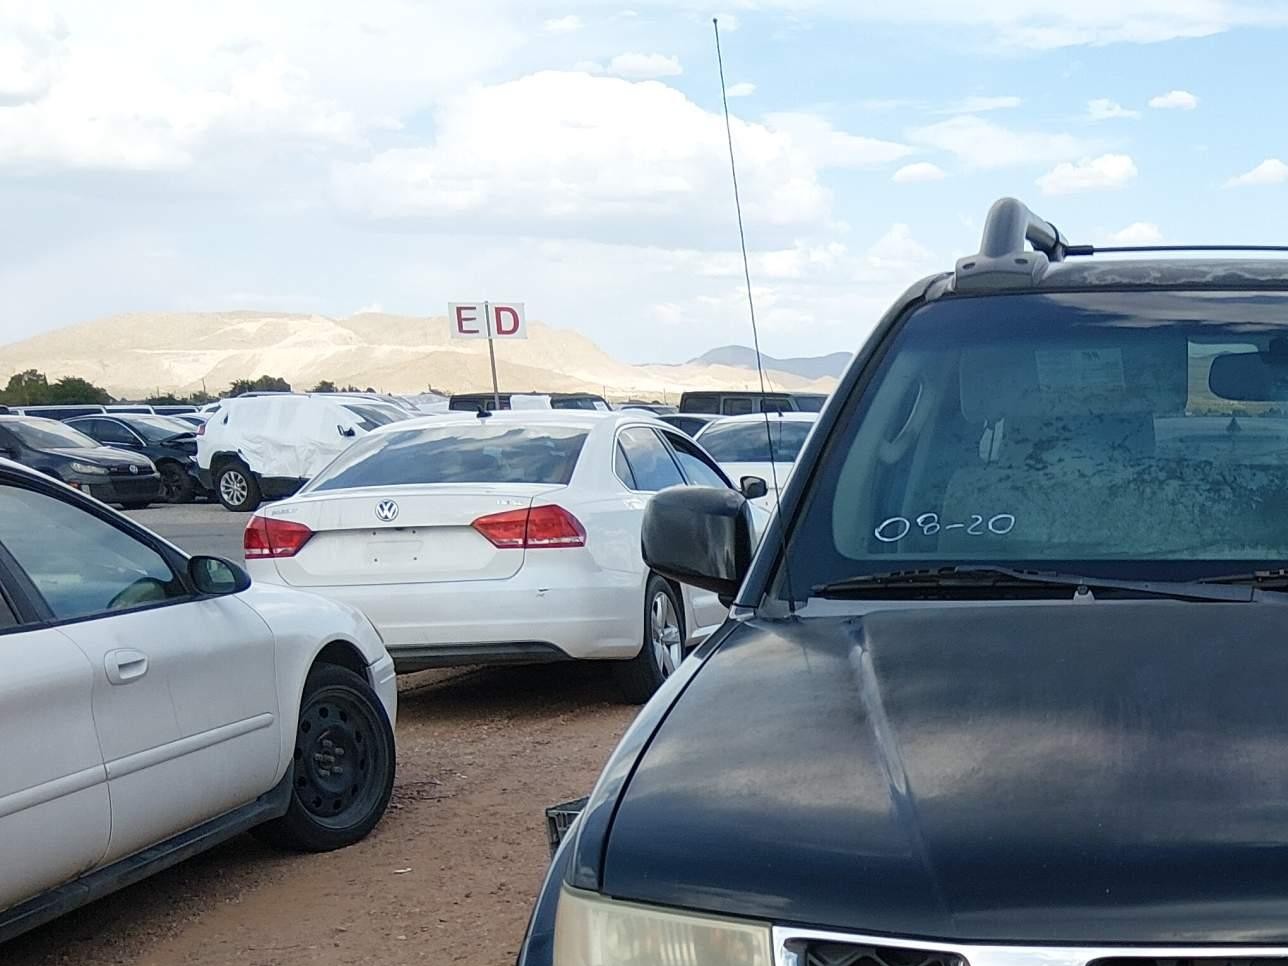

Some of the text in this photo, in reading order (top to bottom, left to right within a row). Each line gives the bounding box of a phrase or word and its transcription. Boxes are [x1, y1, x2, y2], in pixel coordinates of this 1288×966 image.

[456, 306, 520, 335] E D
[875, 513, 1016, 542] 08-20
